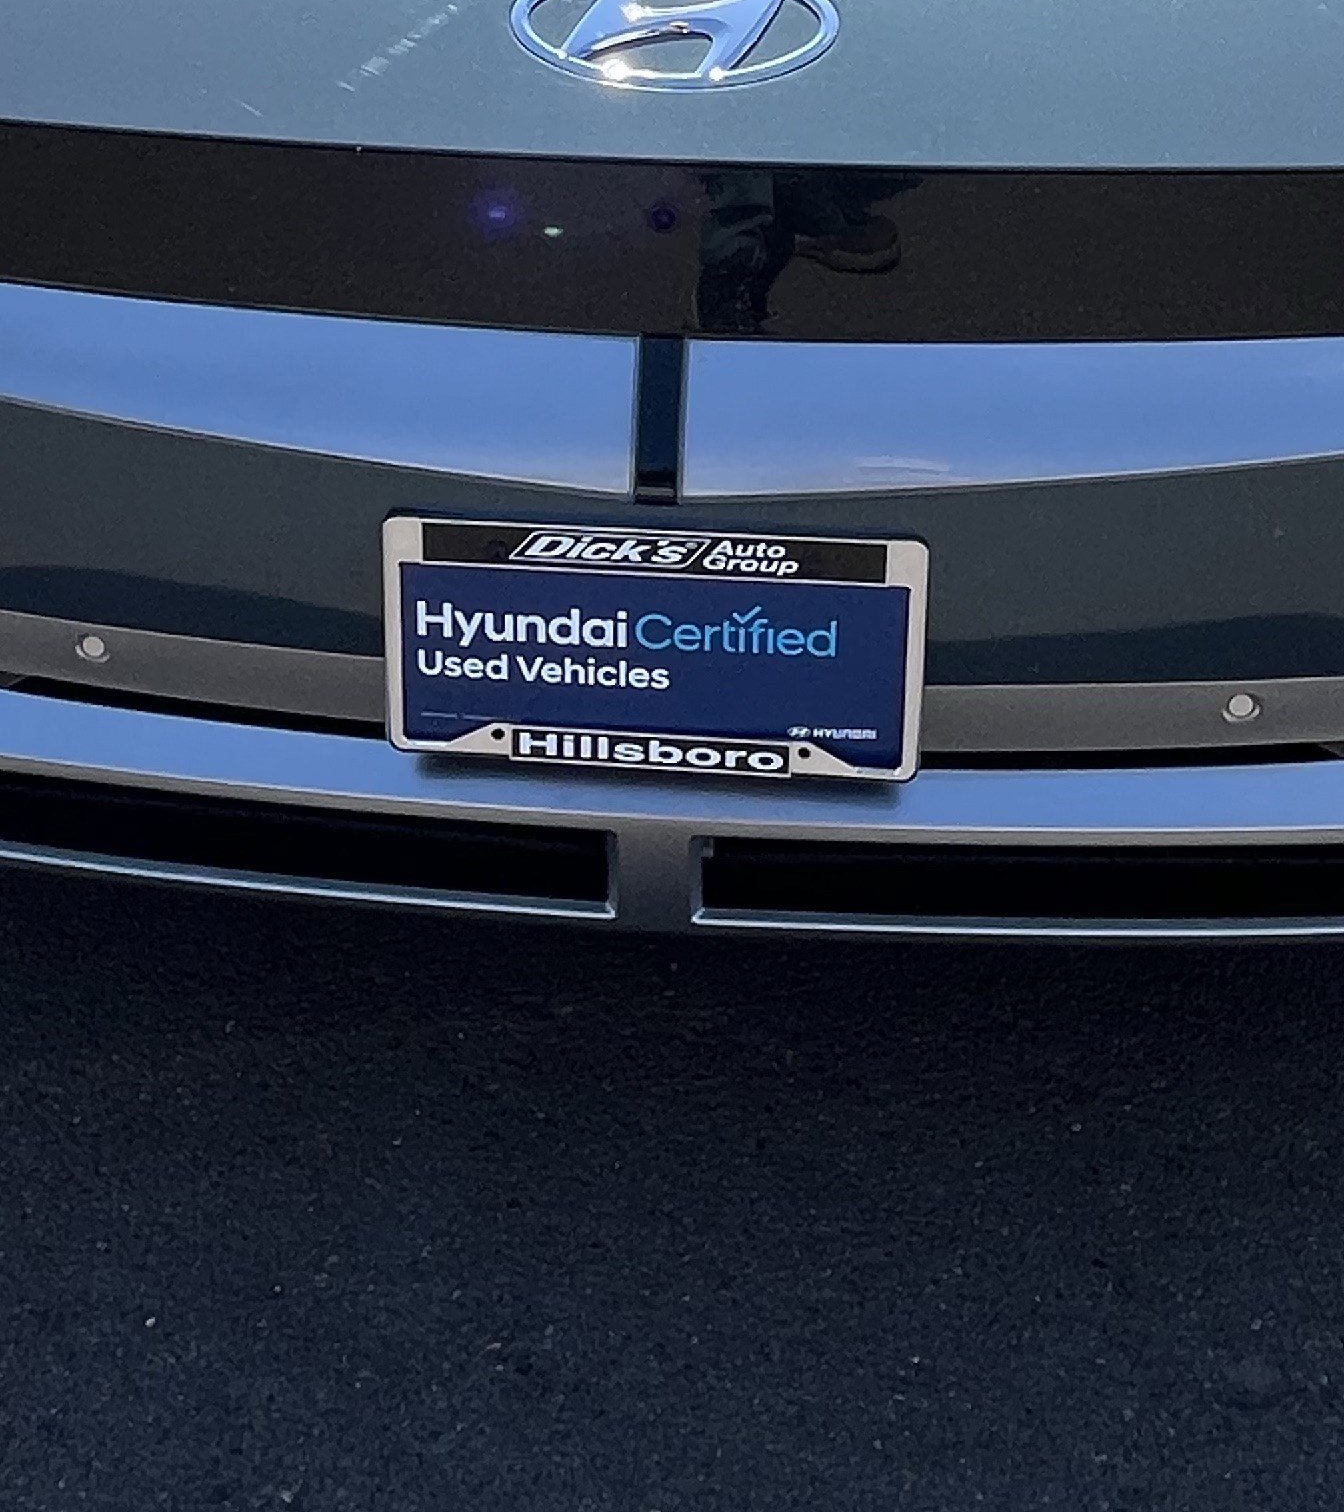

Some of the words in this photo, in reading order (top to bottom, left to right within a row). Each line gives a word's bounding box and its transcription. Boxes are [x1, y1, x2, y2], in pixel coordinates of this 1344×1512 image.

[524, 535, 689, 564] Dick's
[702, 553, 800, 577] Group
[709, 539, 787, 559] Auto
[416, 600, 628, 651] Hyundai
[635, 606, 839, 658] Certified
[417, 649, 509, 682] Used
[516, 654, 671, 690] Vehicles
[517, 730, 786, 771] Hillsboro
